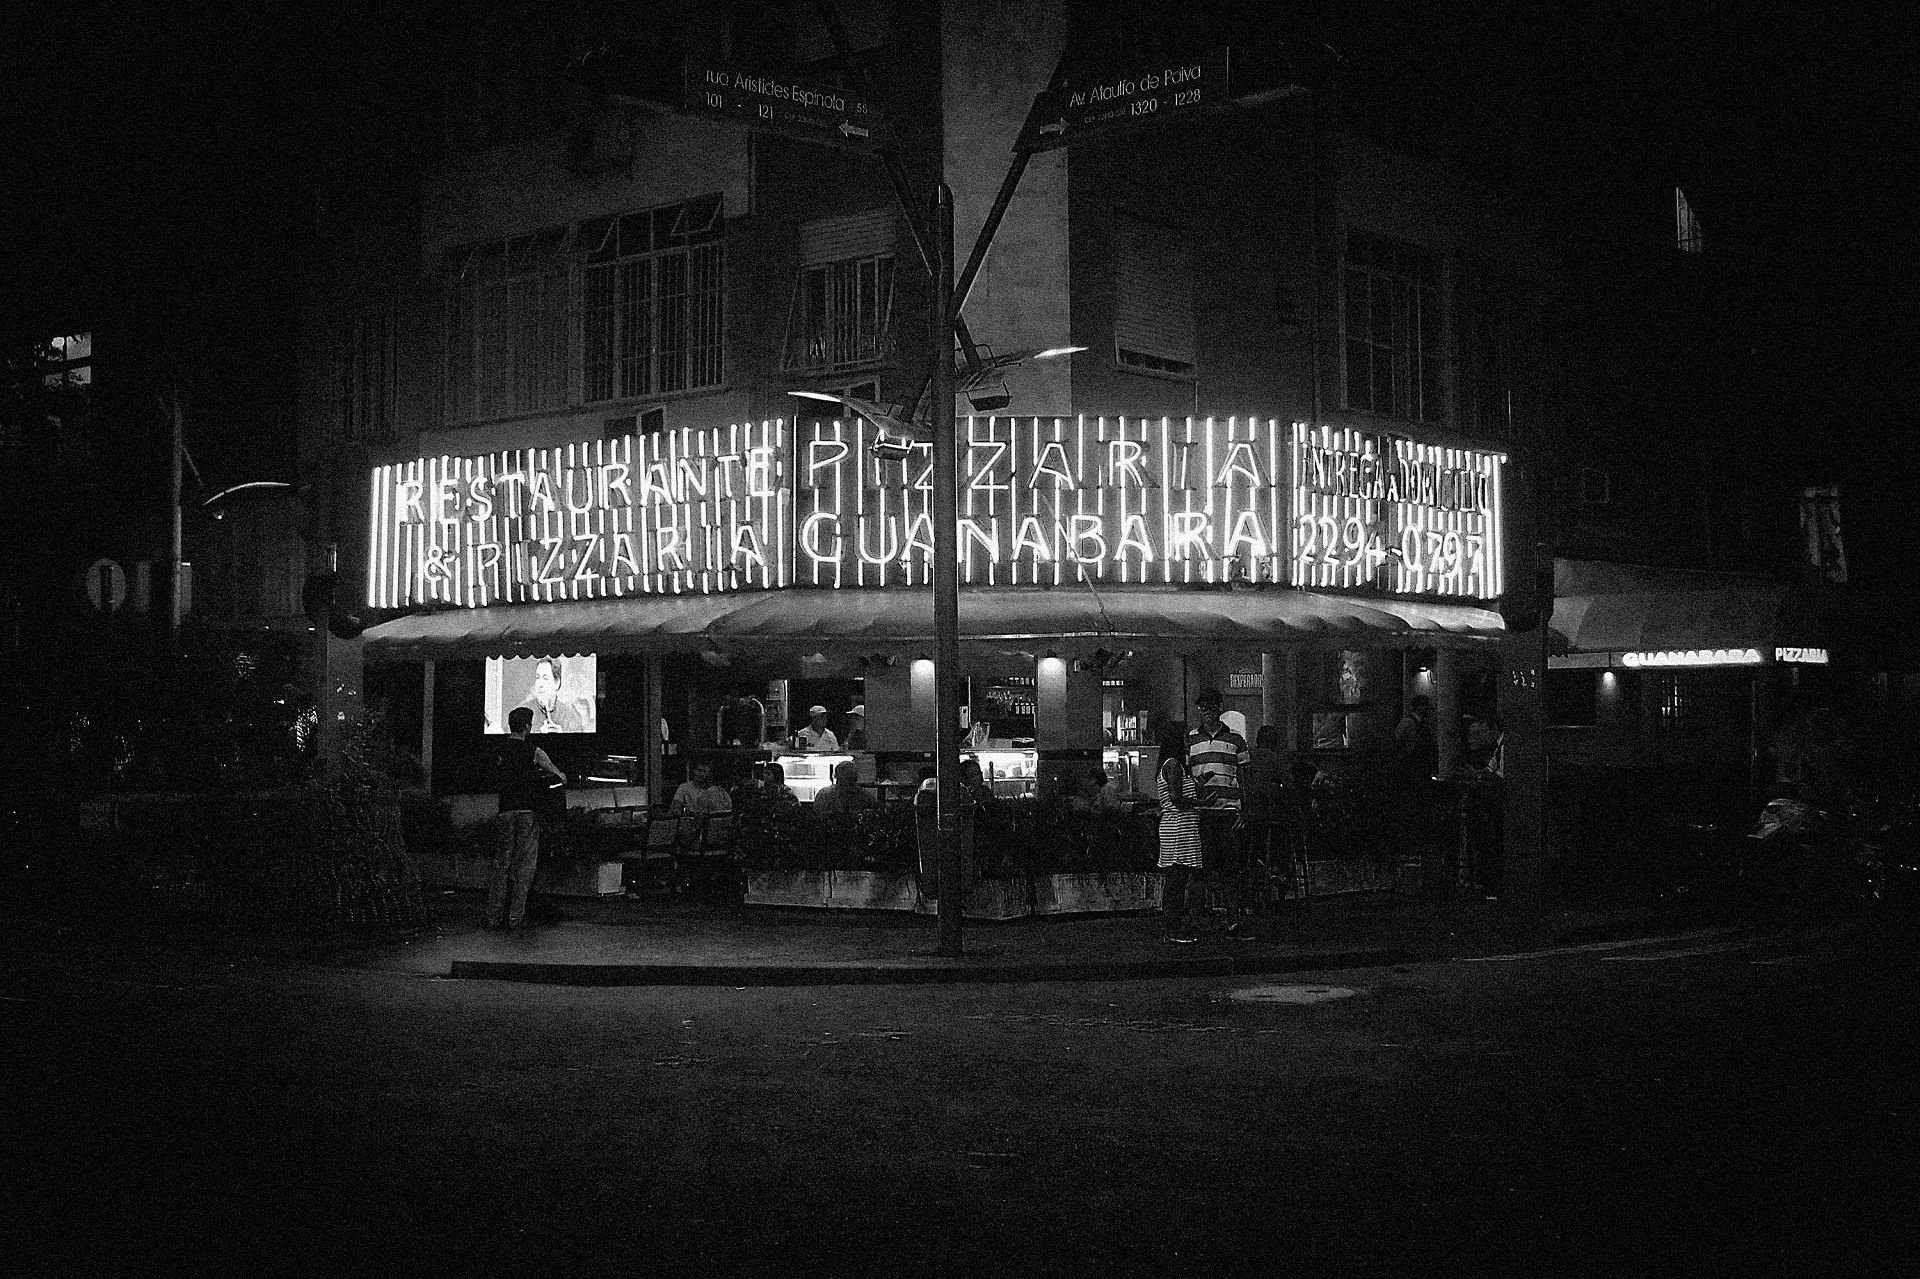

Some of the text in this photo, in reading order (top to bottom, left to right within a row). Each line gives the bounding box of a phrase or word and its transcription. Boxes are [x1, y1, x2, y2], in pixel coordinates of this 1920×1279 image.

[706, 70, 729, 86] rua
[735, 72, 790, 100] Aristides
[1090, 79, 1135, 104] Ataulfo
[1140, 73, 1160, 90] de
[1164, 65, 1201, 86] Paiva
[706, 91, 722, 109] 101
[758, 103, 774, 119] 121
[1130, 98, 1157, 116] 1320
[1174, 88, 1201, 107] 1228
[399, 447, 776, 525] RESTAURANTE
[801, 510, 1269, 564] GUANABARA
[423, 524, 765, 584] & PIZZARIA
[1622, 648, 1761, 667] GUANABARA
[1775, 647, 1829, 664] PIZZARIA
